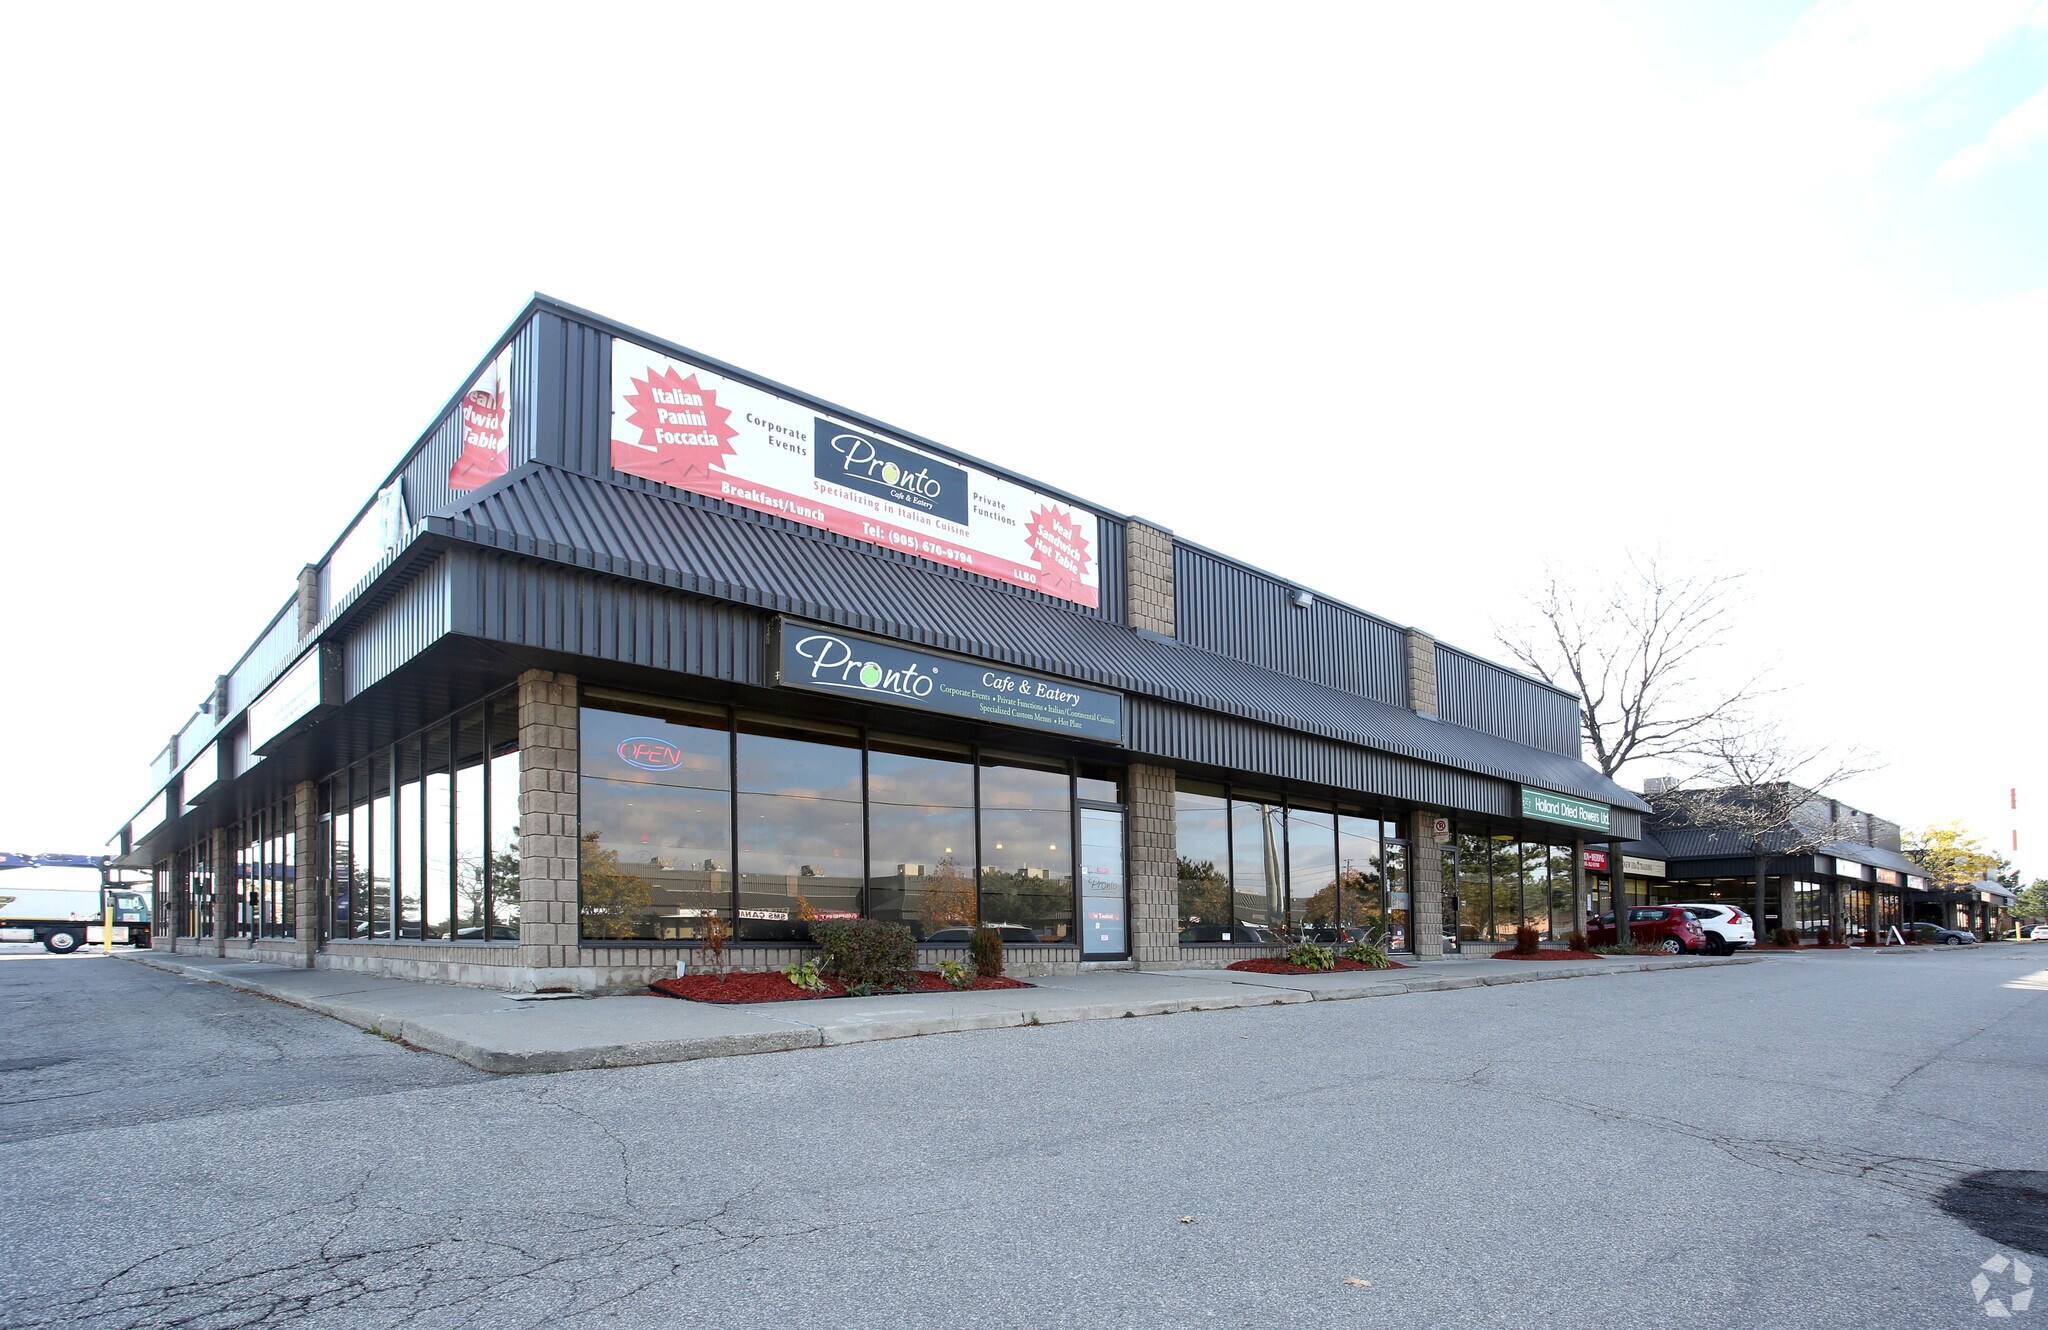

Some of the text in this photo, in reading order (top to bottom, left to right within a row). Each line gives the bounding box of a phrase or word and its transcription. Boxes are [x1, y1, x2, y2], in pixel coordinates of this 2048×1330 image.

[651, 387, 703, 406] Italian
[657, 408, 708, 426] Panini
[746, 413, 807, 441] Corporate
[655, 427, 719, 446] Foccacia
[768, 436, 807, 456] Events
[831, 434, 941, 498] Pronto
[721, 481, 825, 522] Breakfast/Lunch
[814, 481, 970, 538] Specializing in Italian Cuisine
[890, 489, 904, 500] Cafe
[913, 496, 933, 509] Eatery
[973, 492, 1006, 510] Private
[973, 505, 1016, 526] Functions
[1053, 518, 1072, 540] Veal
[862, 522, 973, 565] Tel: (905) 670-9794
[1034, 537, 1078, 575] Hot Table
[1037, 524, 1080, 562] Sandwich
[1013, 568, 1036, 584] LLBO
[795, 635, 933, 697] Pronto
[982, 672, 1080, 707] Cafe & Eatery
[939, 684, 1115, 725] Corporate Events Private Functions Italian/Continental Cuisine
[979, 703, 1082, 729] Specialized Custom Menus Hot Plate
[619, 743, 681, 765] OPEN
[1535, 797, 1560, 815] Holland
[1561, 802, 1578, 819] Dried
[1579, 806, 1599, 823] Flowers
